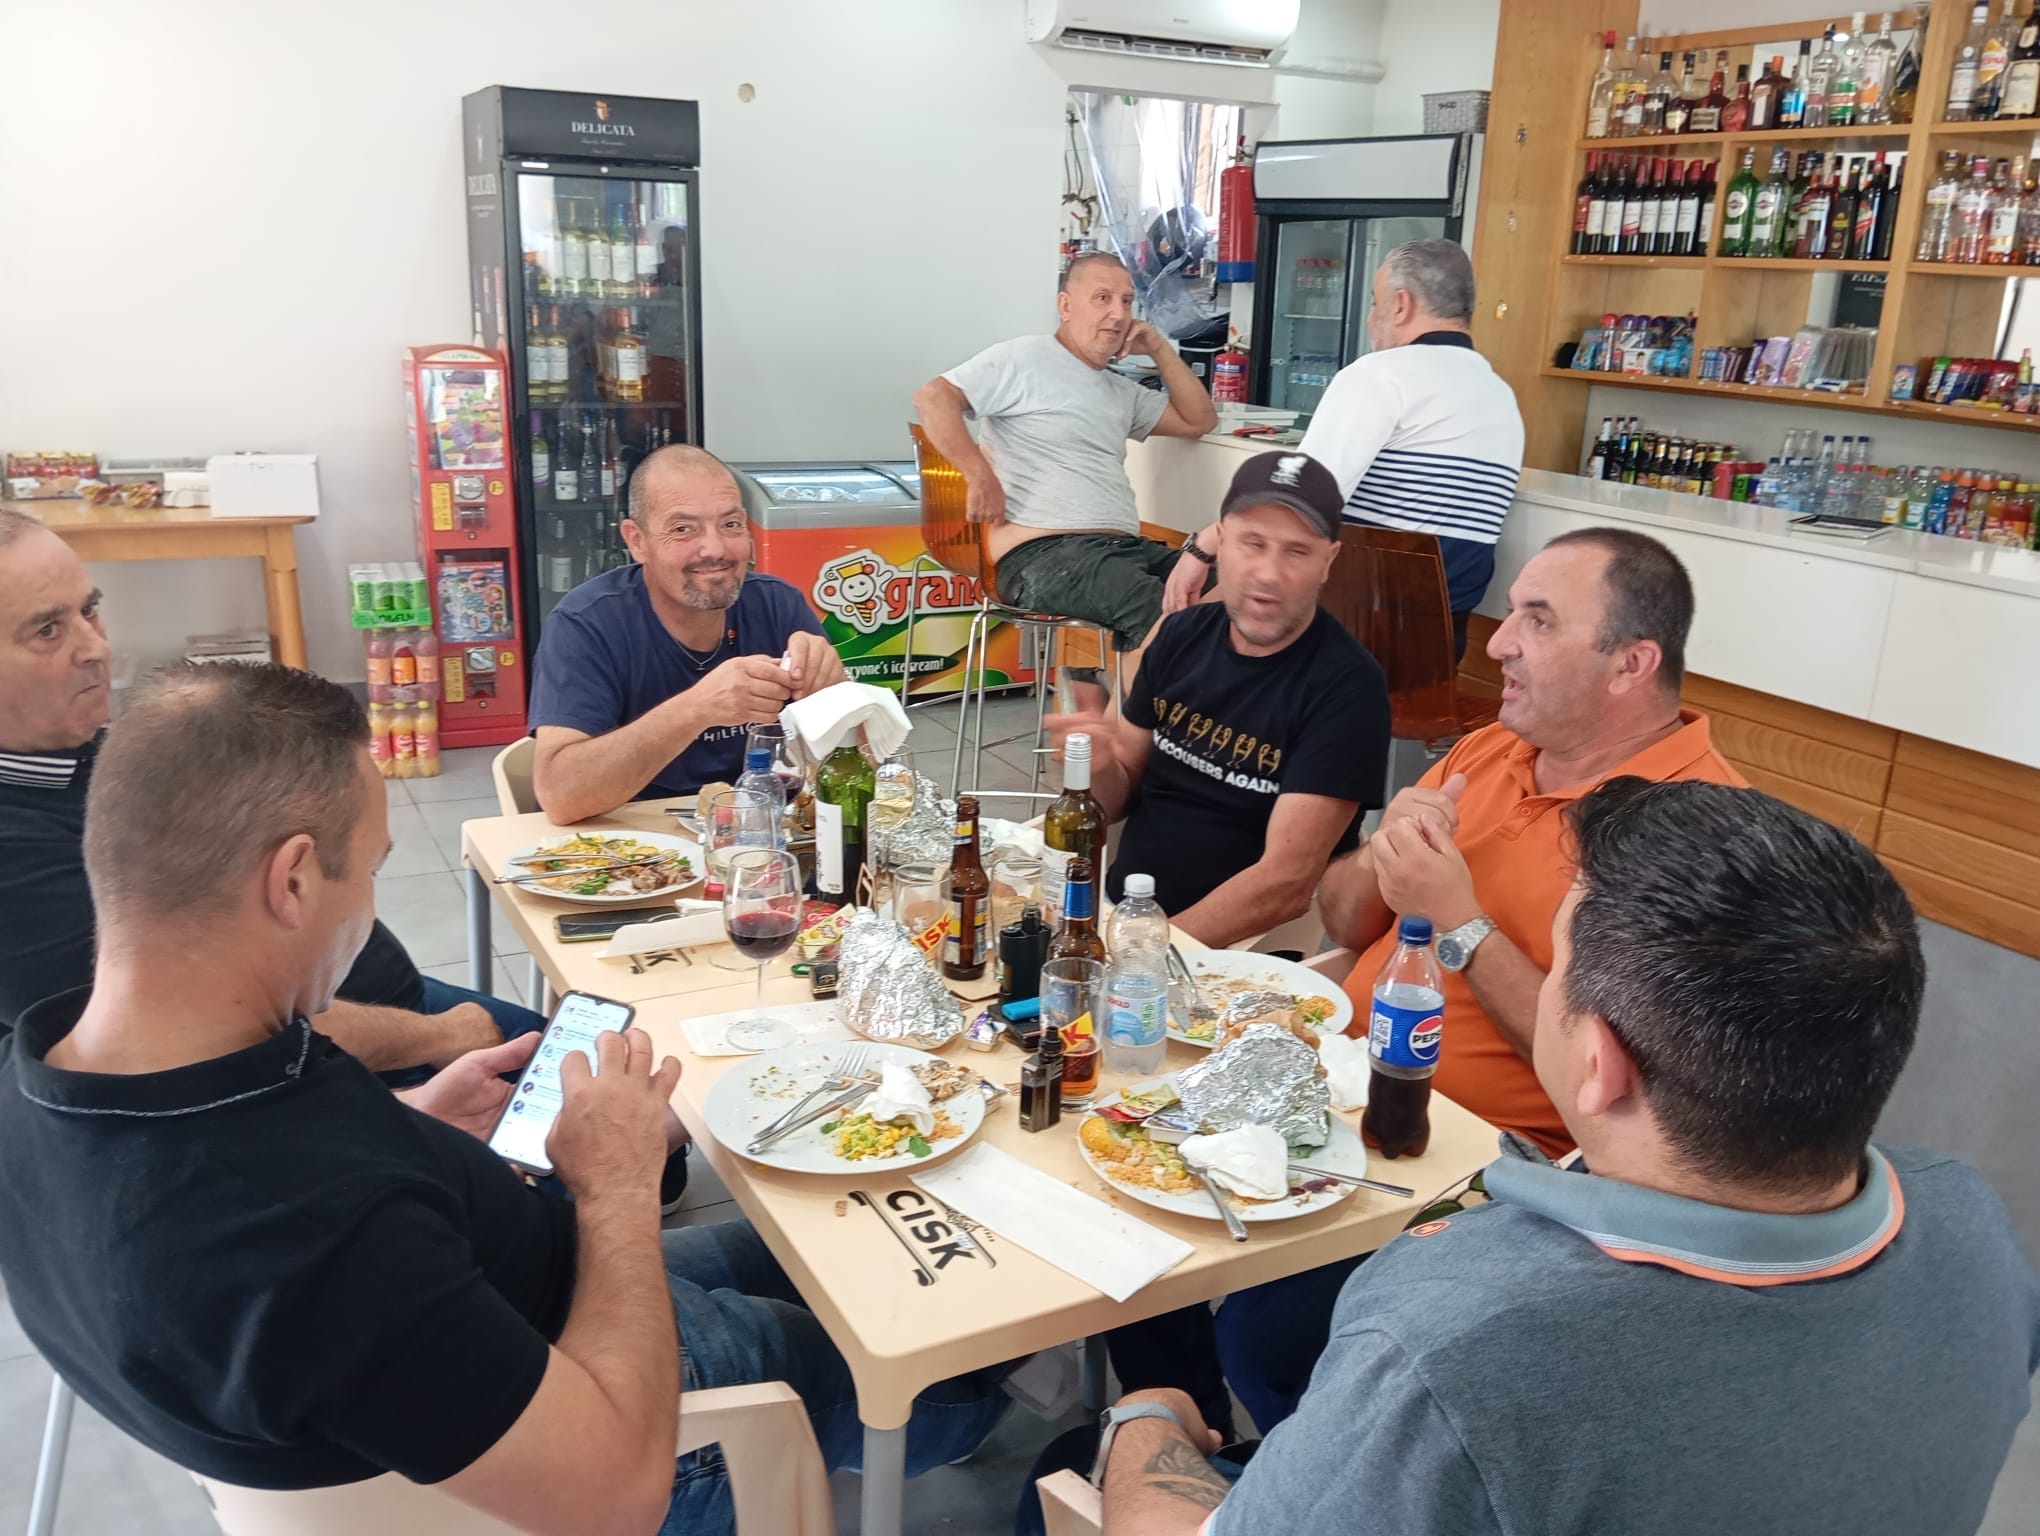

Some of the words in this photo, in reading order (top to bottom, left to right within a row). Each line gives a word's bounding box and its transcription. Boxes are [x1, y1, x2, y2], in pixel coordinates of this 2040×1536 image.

[571, 121, 636, 137] DELICATA
[1158, 738, 1224, 780] SCOUSERS
[1224, 771, 1280, 794] AGAIN
[886, 1190, 976, 1270] CISK
